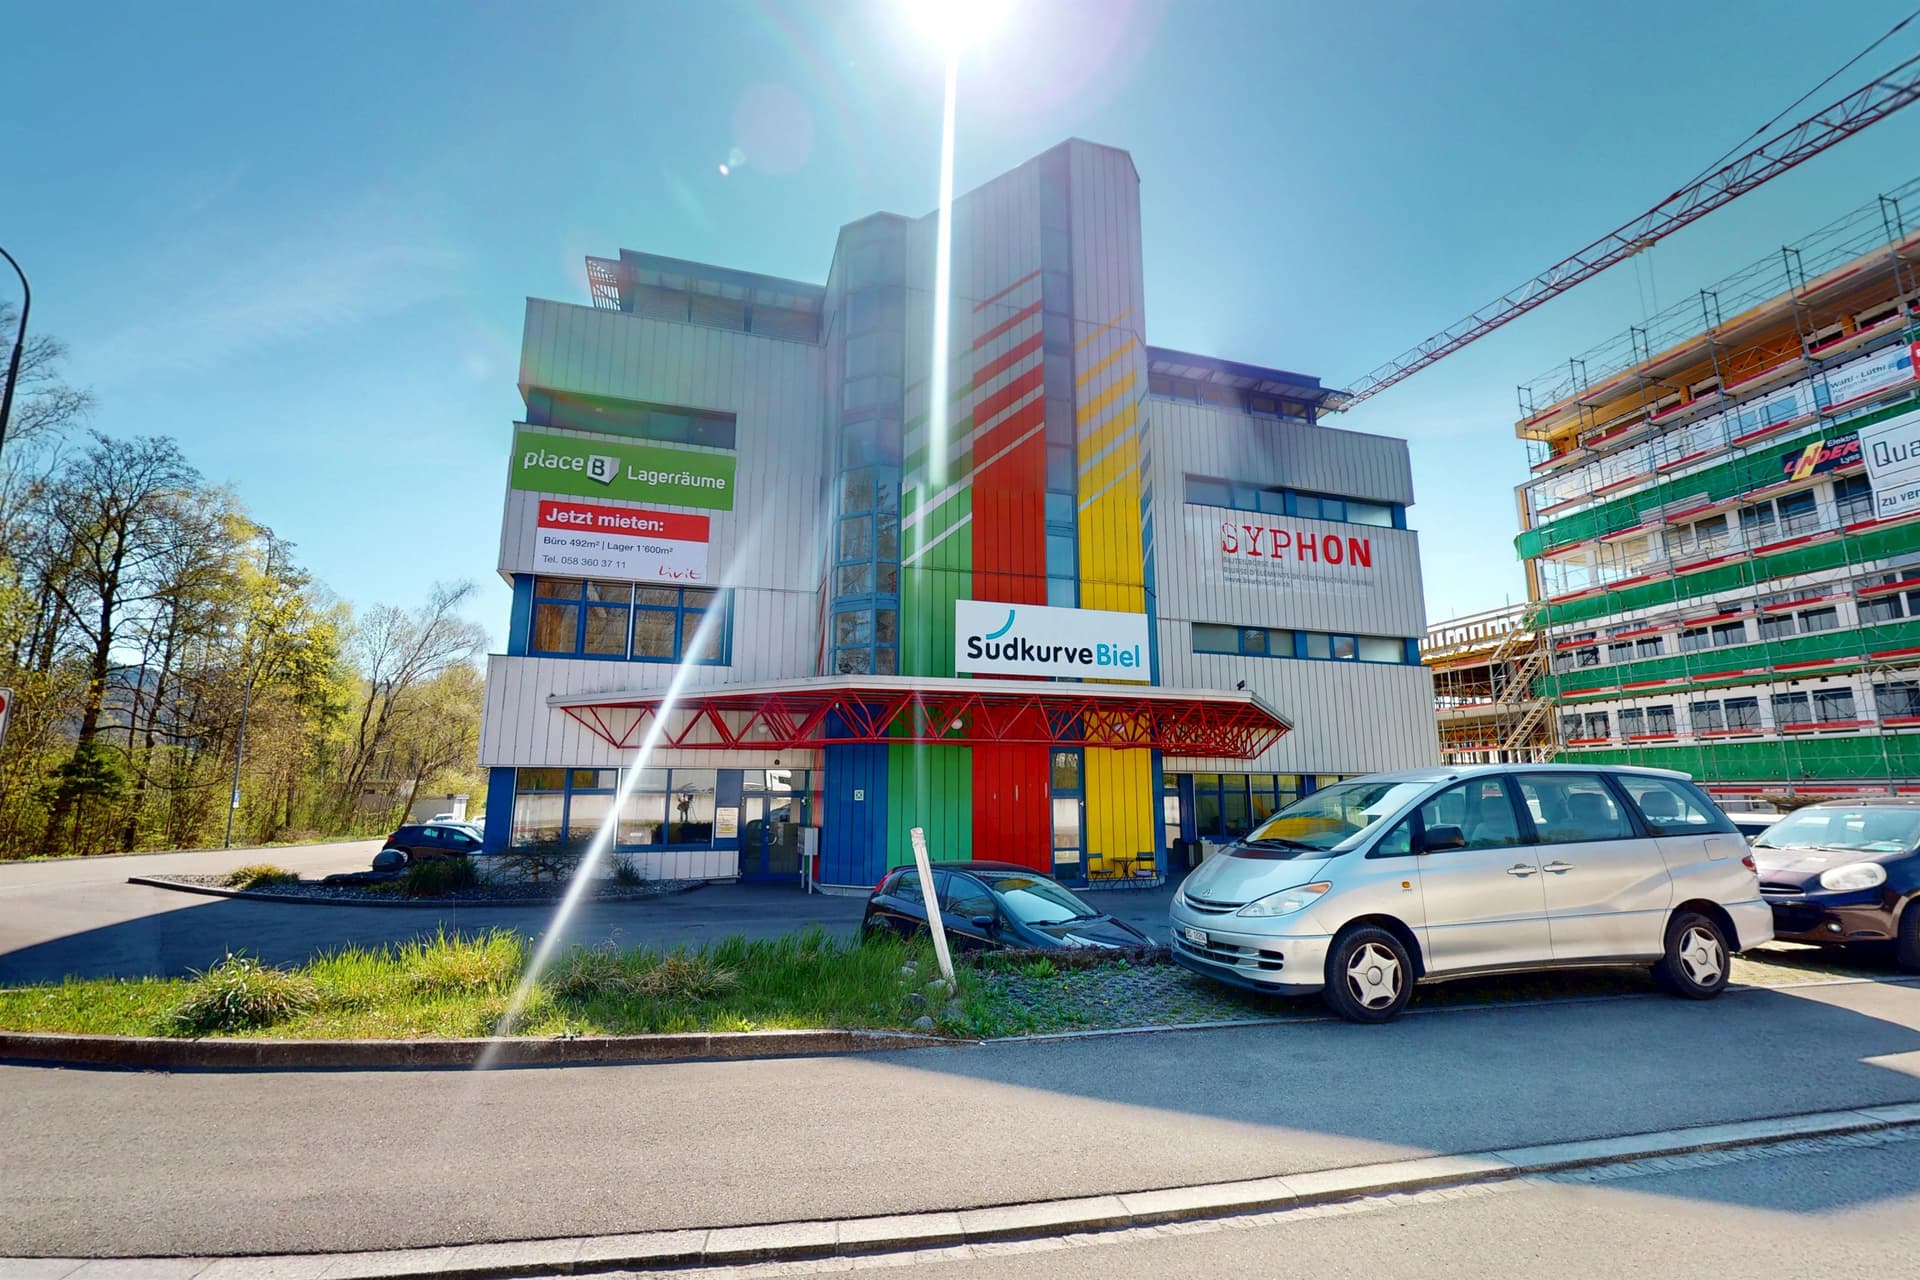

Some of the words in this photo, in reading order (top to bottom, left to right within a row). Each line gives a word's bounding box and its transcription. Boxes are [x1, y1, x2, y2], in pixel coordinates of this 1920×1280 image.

[1827, 433, 1858, 447] Elektro
[523, 449, 585, 471] place
[626, 465, 726, 490] Lagerräume
[1881, 496, 1897, 507] zu
[545, 507, 593, 525] Jetzt
[597, 514, 664, 532] mieten:
[543, 535, 567, 547] Büro
[607, 541, 634, 553] Lager
[1221, 521, 1372, 568] SYPHON
[542, 554, 559, 564] Tel.
[560, 556, 579, 566] 058
[580, 557, 599, 567] 360
[600, 558, 614, 568] 37
[616, 560, 626, 569] 11
